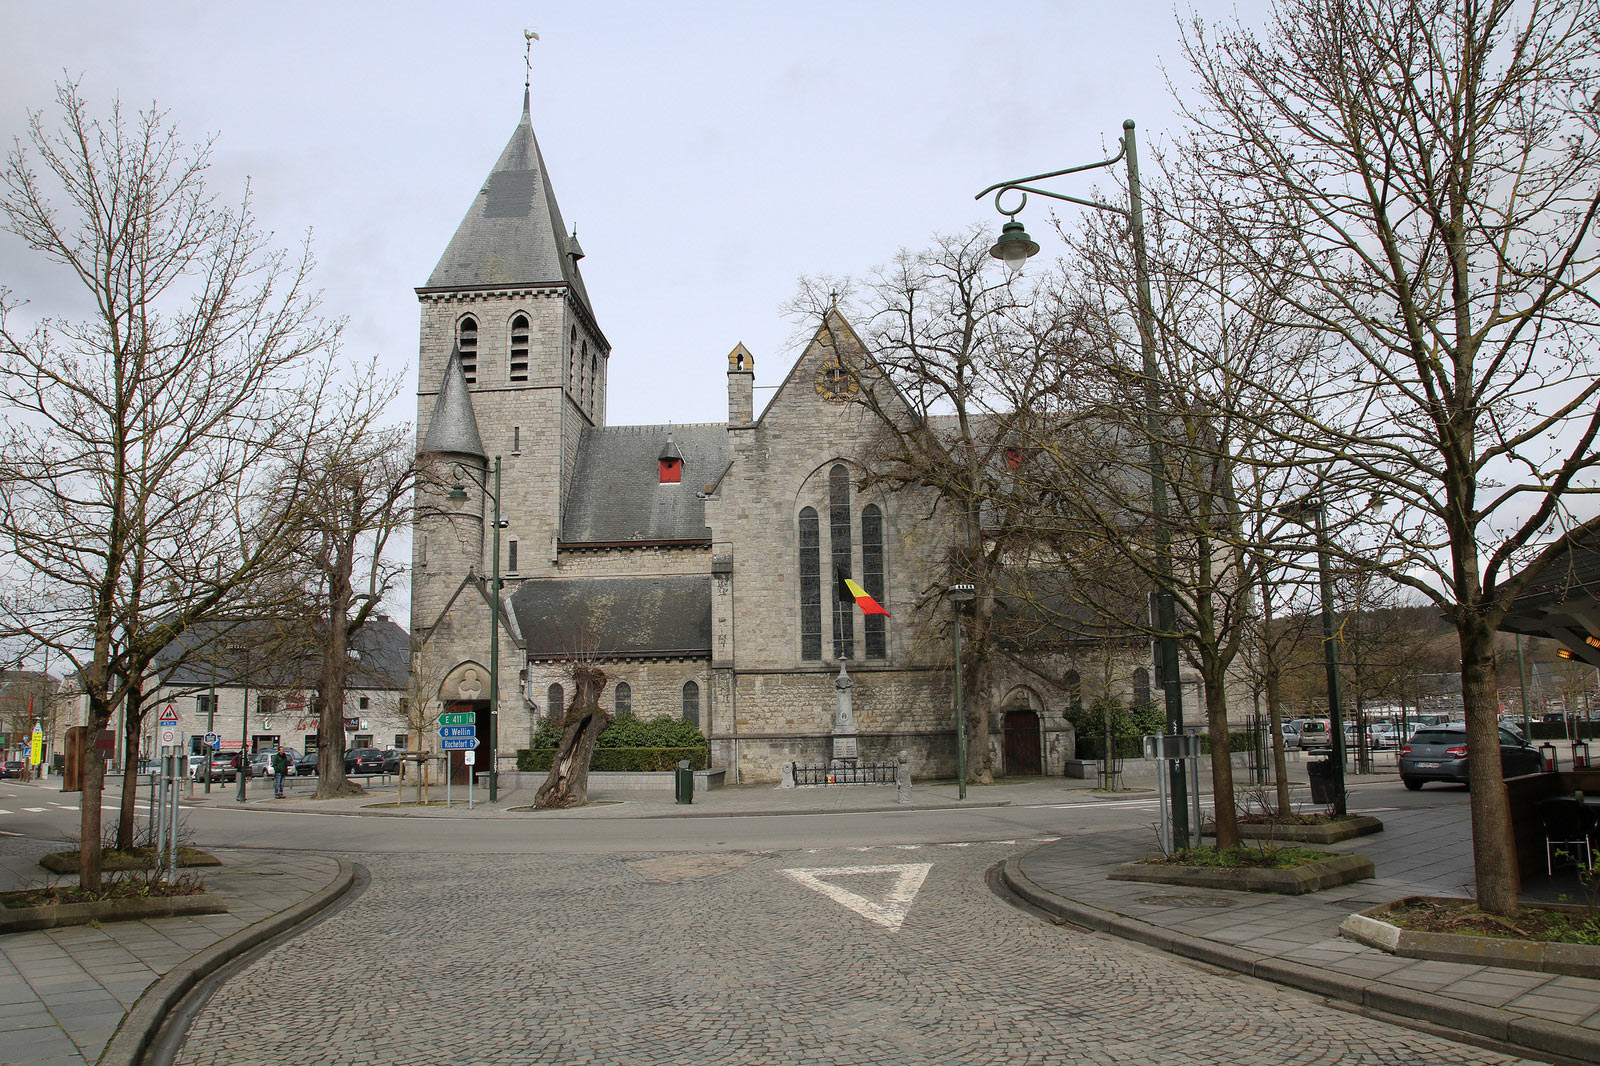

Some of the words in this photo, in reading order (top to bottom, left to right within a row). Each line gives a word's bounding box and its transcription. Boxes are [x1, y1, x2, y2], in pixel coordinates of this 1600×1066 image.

[452, 715, 462, 723] 411
[444, 728, 449, 736] 8
[451, 727, 471, 736] Wellin
[444, 740, 468, 748] Rochefort
[469, 739, 474, 748] 6
